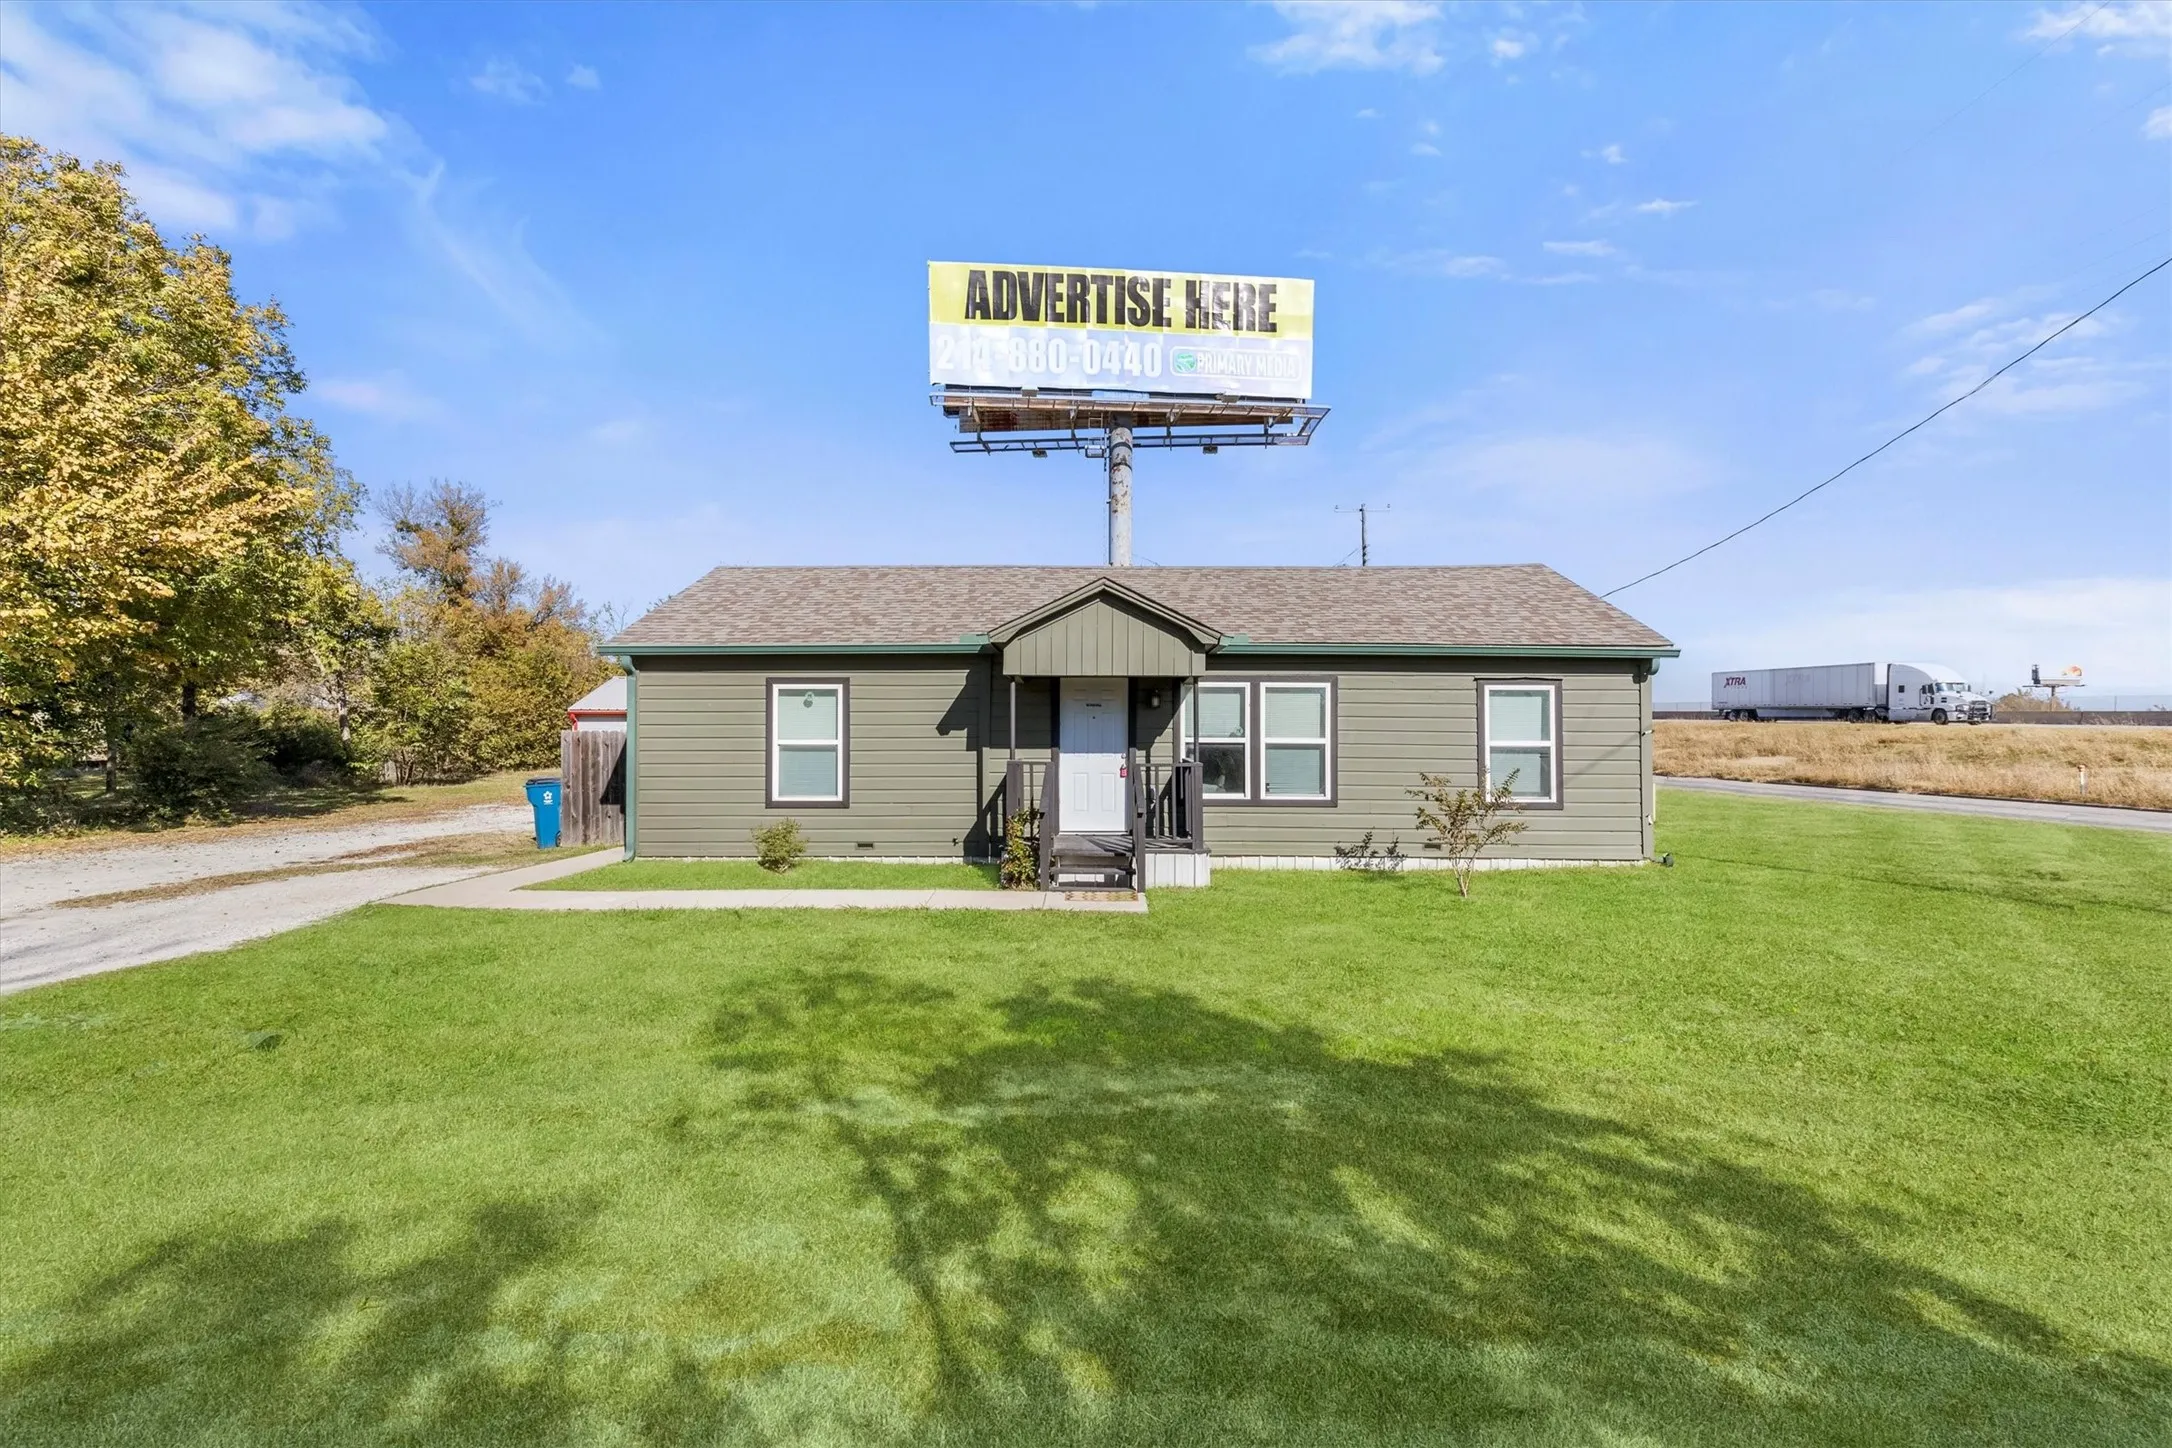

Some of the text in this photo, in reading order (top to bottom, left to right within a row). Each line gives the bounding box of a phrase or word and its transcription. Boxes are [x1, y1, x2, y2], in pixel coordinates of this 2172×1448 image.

[964, 269, 1278, 333] ADVERTISE HERE
[937, 335, 1162, 378] 214-880-0440
[1196, 351, 1297, 378] PRIMARY MEDIA
[1723, 676, 1746, 688] XTRA
